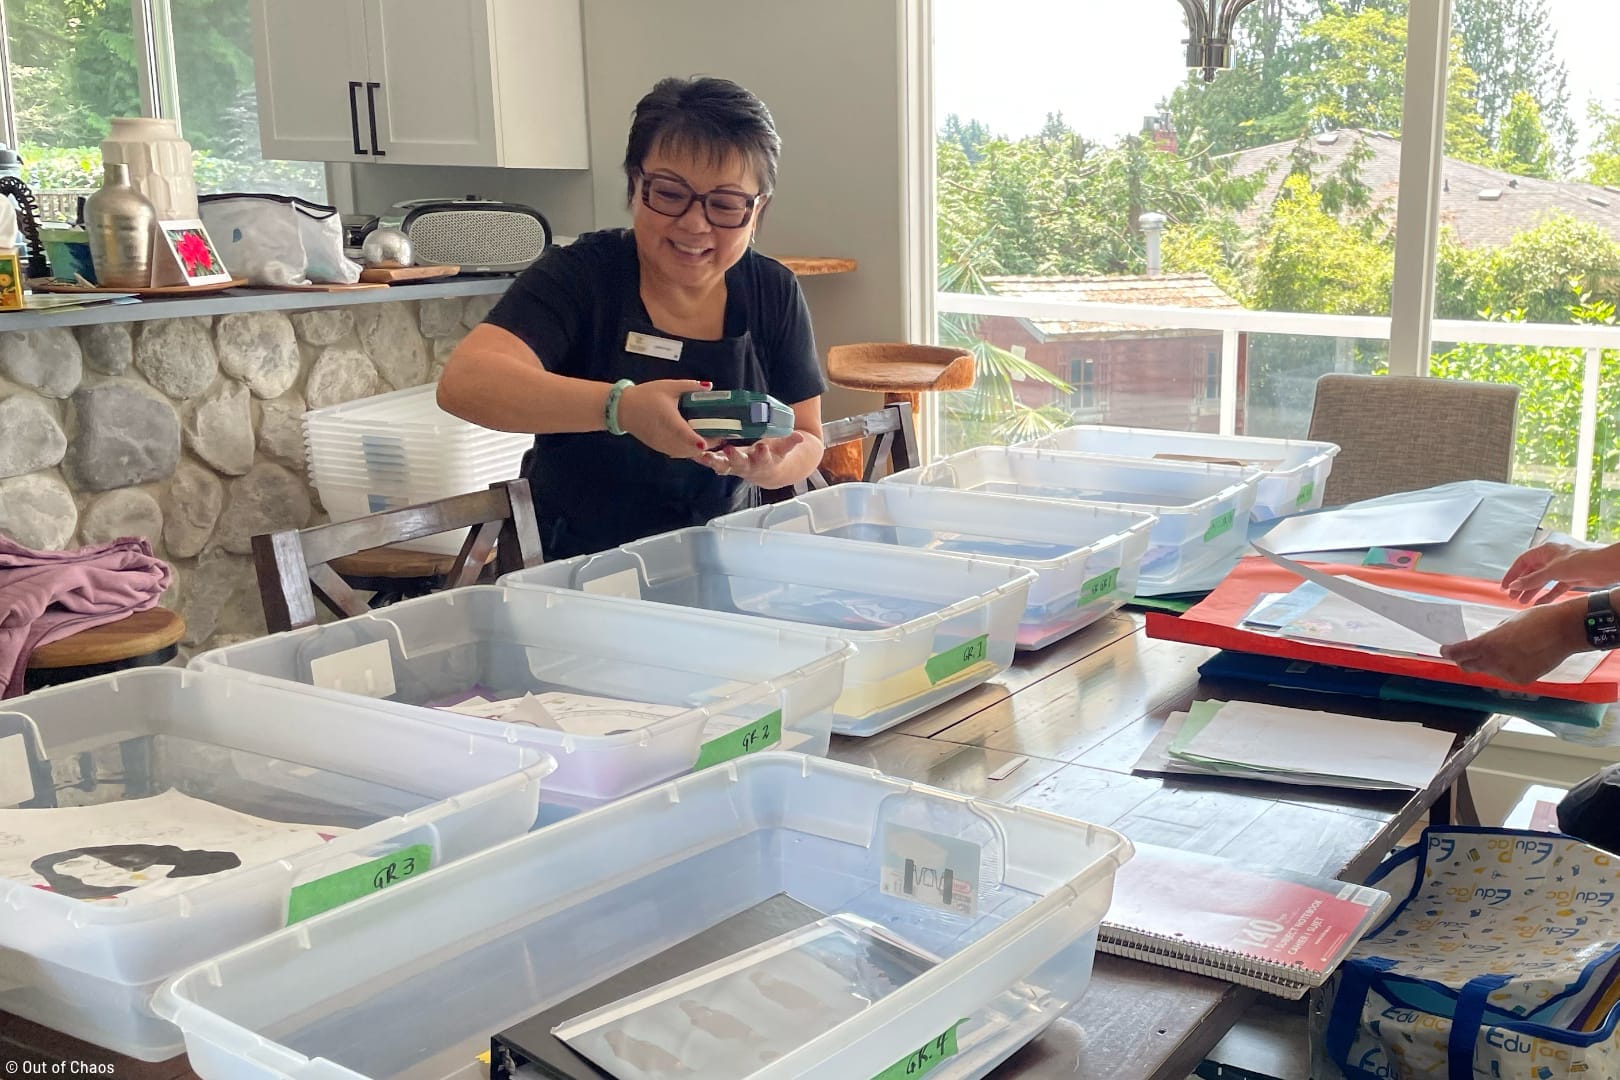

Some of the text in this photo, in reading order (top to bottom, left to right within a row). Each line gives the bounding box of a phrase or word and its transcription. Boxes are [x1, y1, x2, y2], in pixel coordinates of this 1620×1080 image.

[762, 724, 770, 740] 2
[1488, 837, 1552, 865] EduPac
[373, 857, 416, 889] GR 3
[1544, 887, 1615, 909] EduPac
[1297, 898, 1323, 928] NOTEBOOK
[1309, 917, 1324, 932] SUJET
[1232, 918, 1285, 949] 140
[937, 1031, 948, 1056] 4
